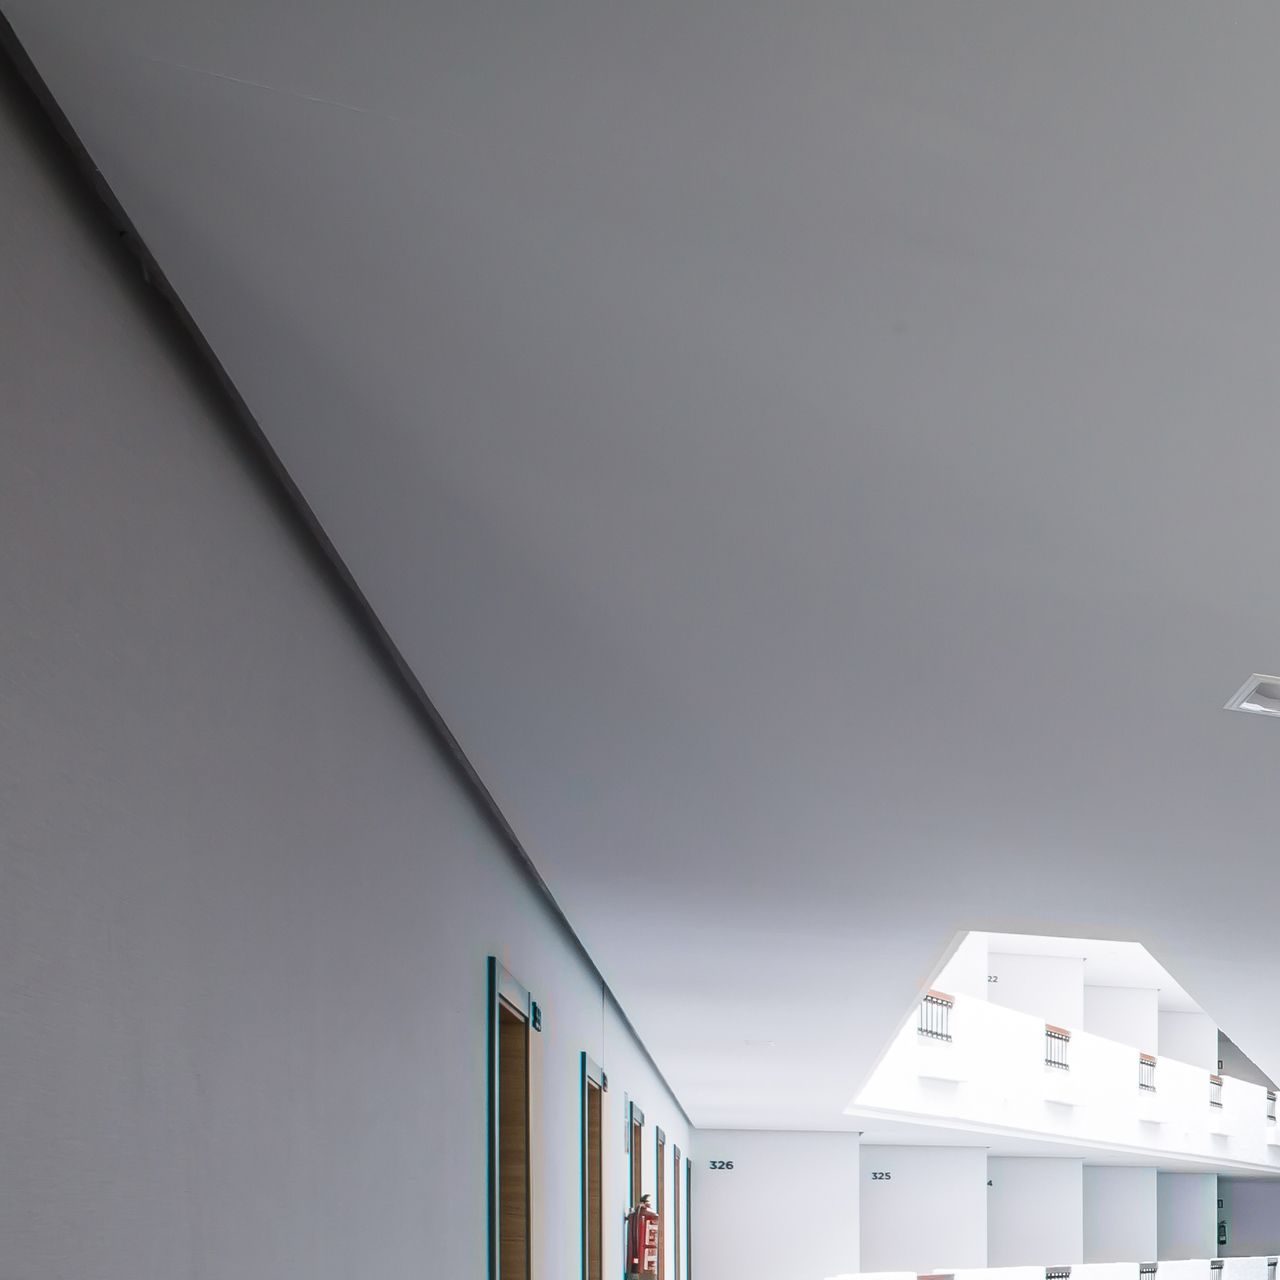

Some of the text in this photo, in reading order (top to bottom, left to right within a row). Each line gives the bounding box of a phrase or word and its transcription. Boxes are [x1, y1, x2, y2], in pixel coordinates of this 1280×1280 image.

[987, 975, 999, 983] 22
[709, 1160, 734, 1170] 326
[871, 1172, 892, 1180] 325
